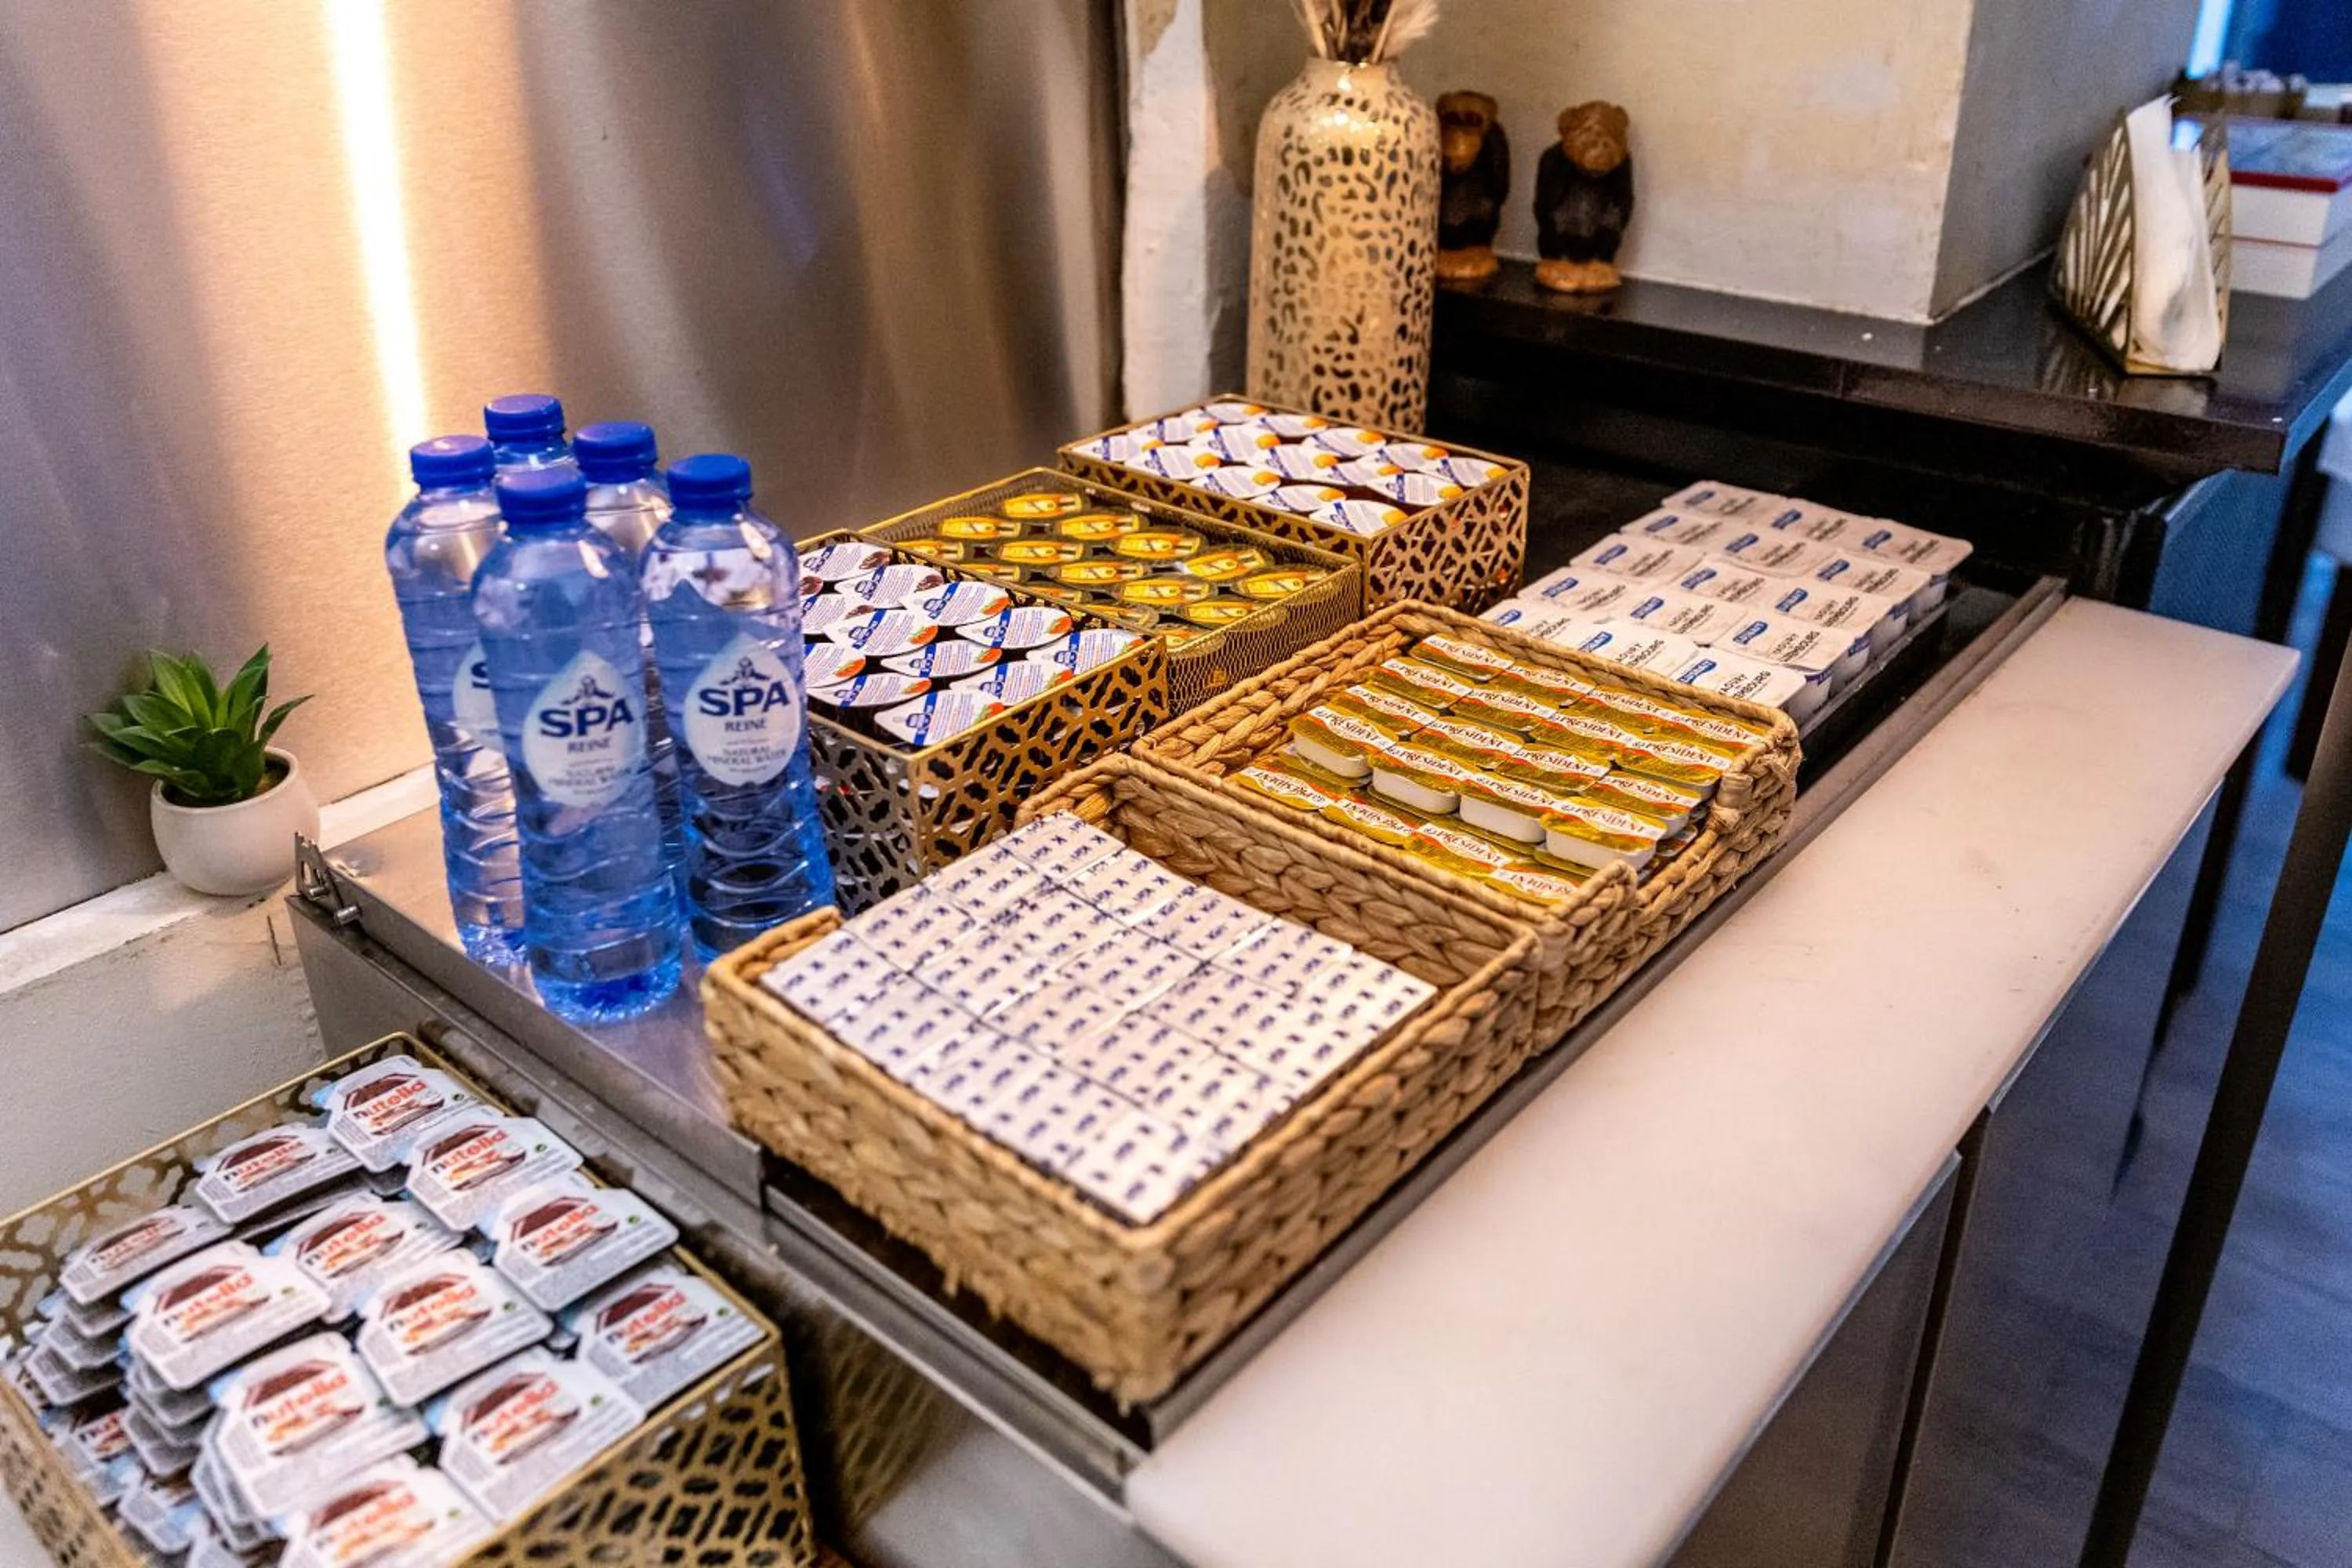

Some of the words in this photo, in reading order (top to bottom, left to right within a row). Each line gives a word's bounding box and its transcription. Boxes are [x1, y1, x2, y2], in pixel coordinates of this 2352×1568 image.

[539, 697, 634, 738] SPA
[699, 681, 789, 717] SPA
[724, 719, 768, 731] REINE
[354, 1080, 426, 1120] nutella
[431, 1129, 509, 1174] nutella
[306, 1214, 387, 1265] nutella
[521, 1204, 600, 1252] nutella
[163, 1274, 255, 1326] nutella
[388, 1286, 477, 1332] nutella
[606, 1291, 687, 1345] nutella
[251, 1371, 348, 1429] nutella
[471, 1379, 561, 1443] nutella
